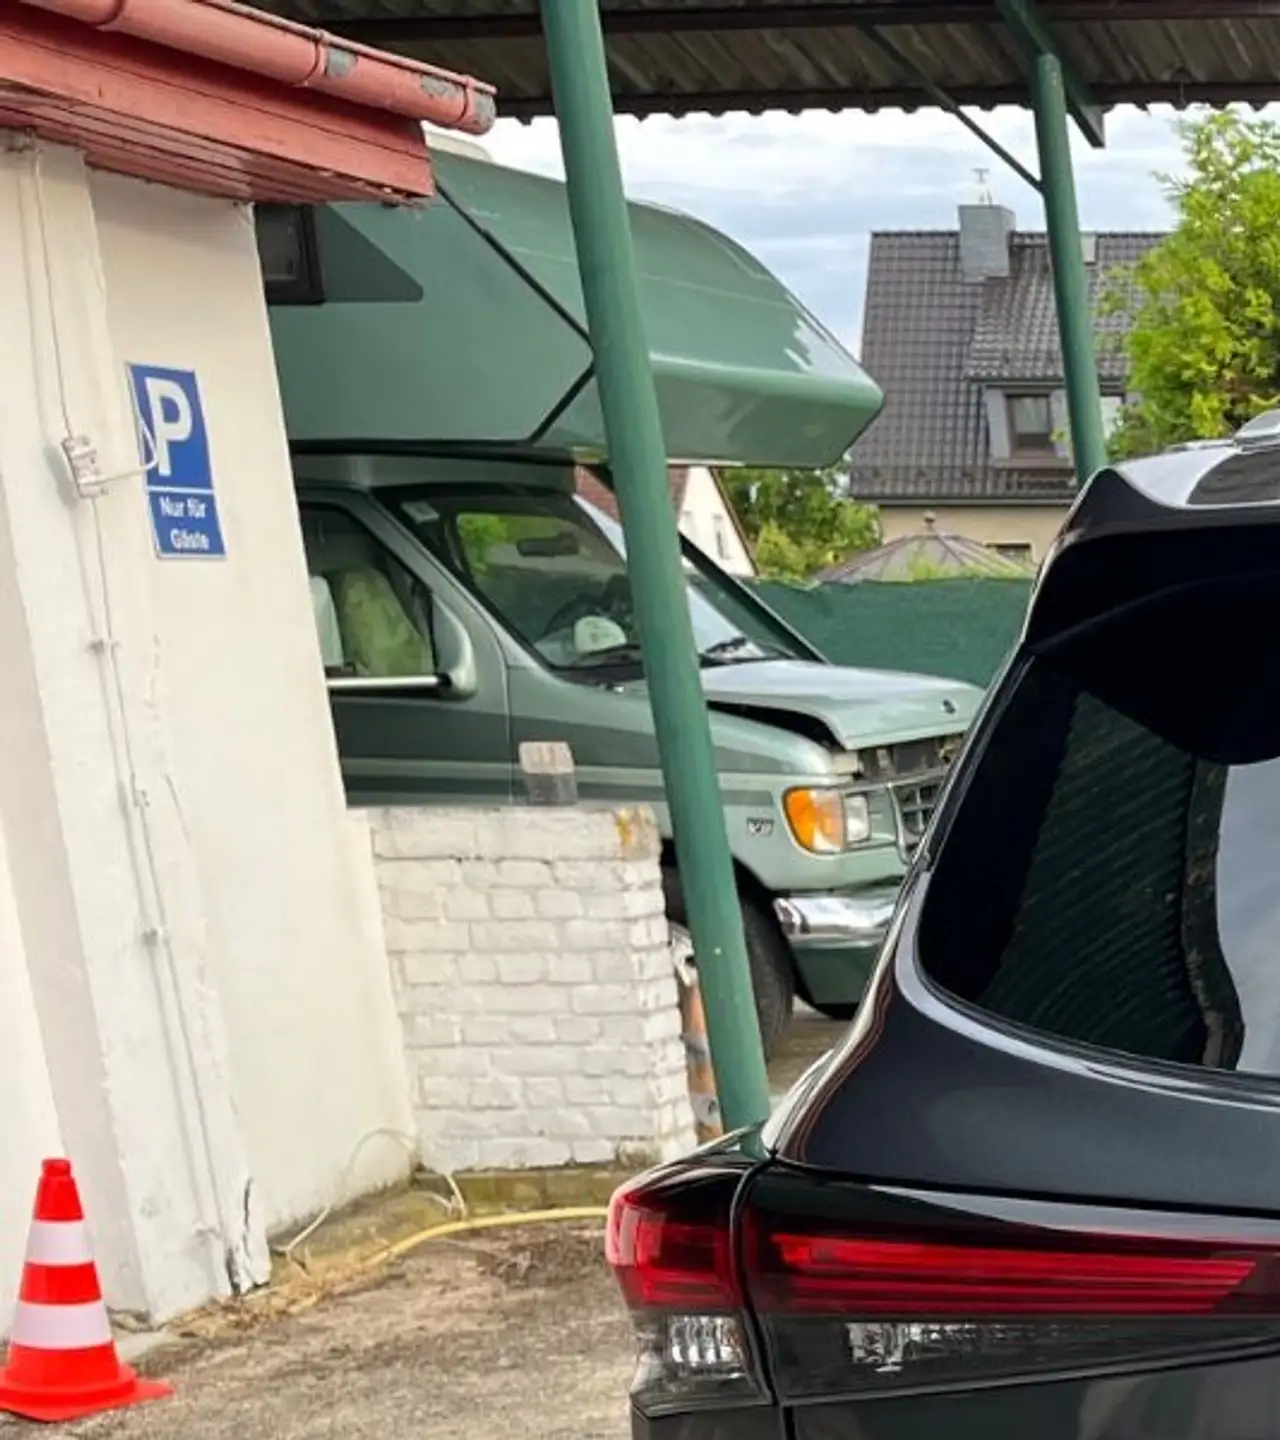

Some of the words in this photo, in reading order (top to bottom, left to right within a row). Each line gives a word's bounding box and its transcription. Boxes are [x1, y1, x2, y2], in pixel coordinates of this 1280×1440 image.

[144, 376, 193, 477] P
[159, 496, 184, 518] Nur
[186, 497, 206, 518] für
[169, 528, 210, 551] Gäste
